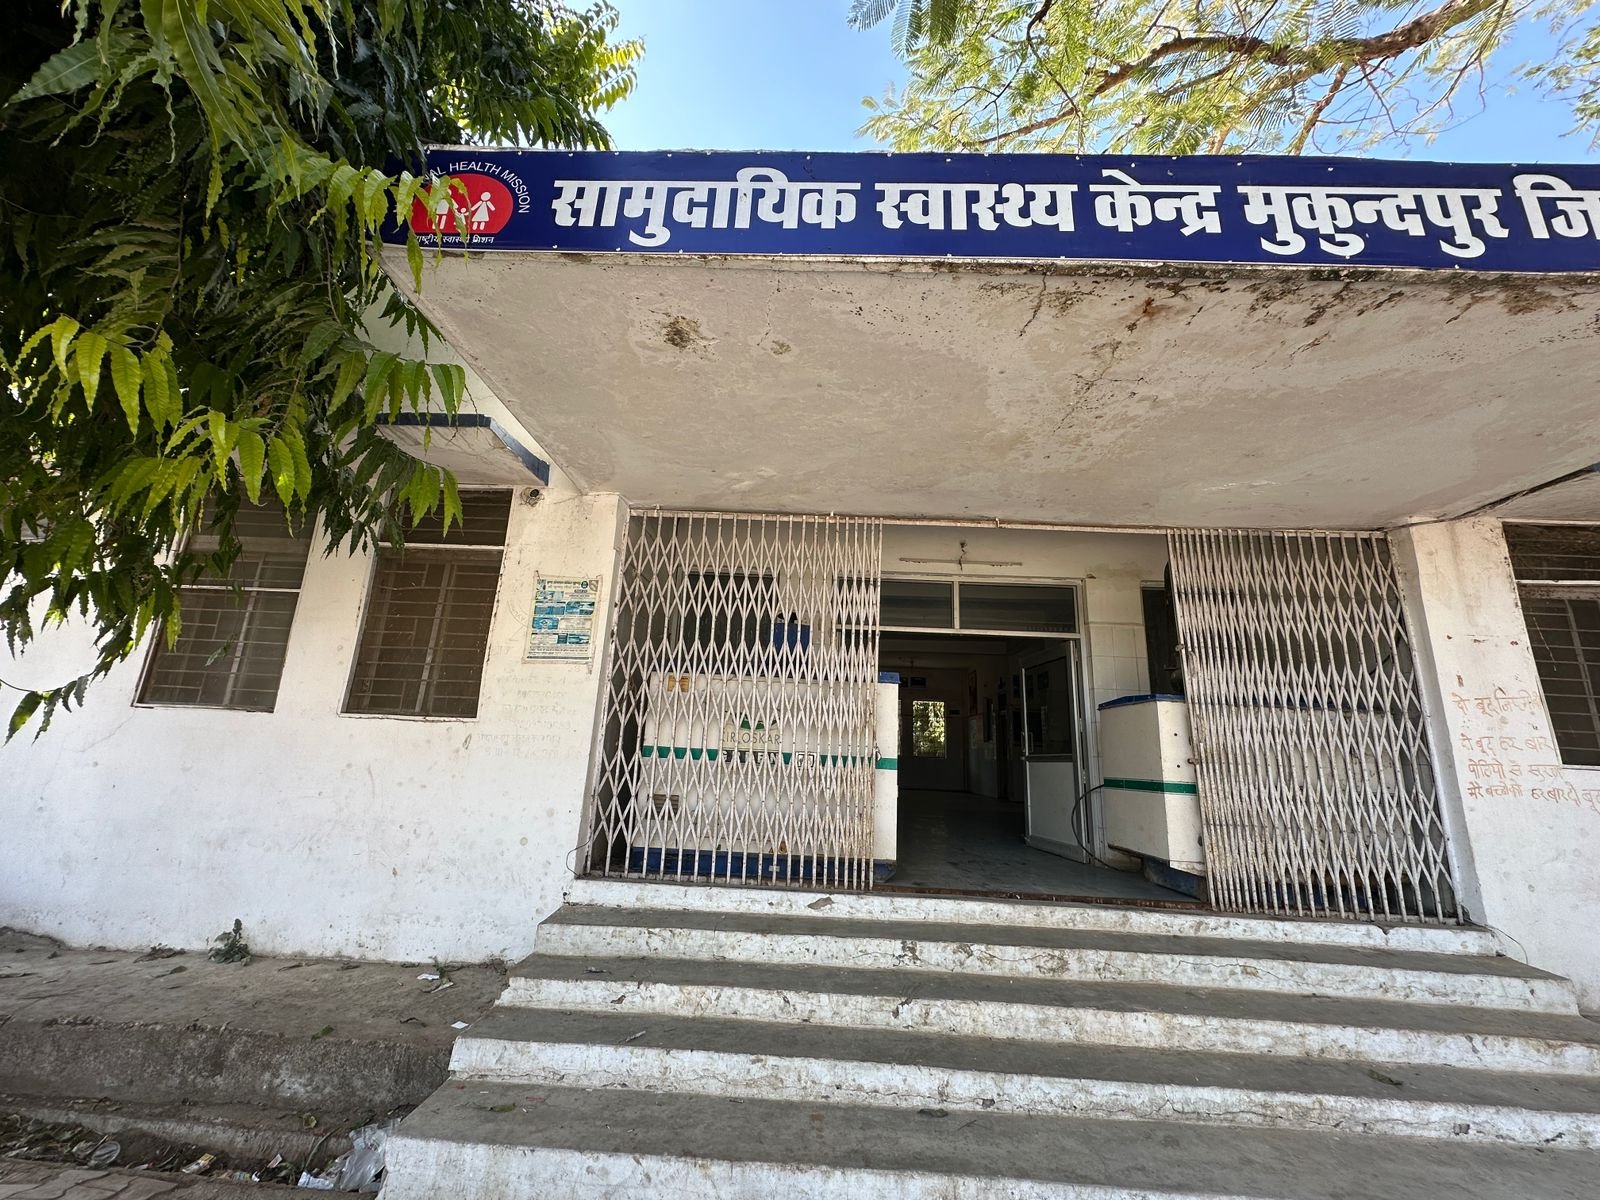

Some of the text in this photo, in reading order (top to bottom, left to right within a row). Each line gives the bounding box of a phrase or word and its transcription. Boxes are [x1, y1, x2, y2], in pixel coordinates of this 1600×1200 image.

[449, 161, 502, 175] HEALTH
[500, 169, 531, 213] MISSION
[551, 167, 861, 247] सामुदायिक
[874, 183, 1078, 232] स्वास्थ्य
[1089, 168, 1222, 237] केन्द्र
[1236, 185, 1502, 258] मुकुन्दपुर
